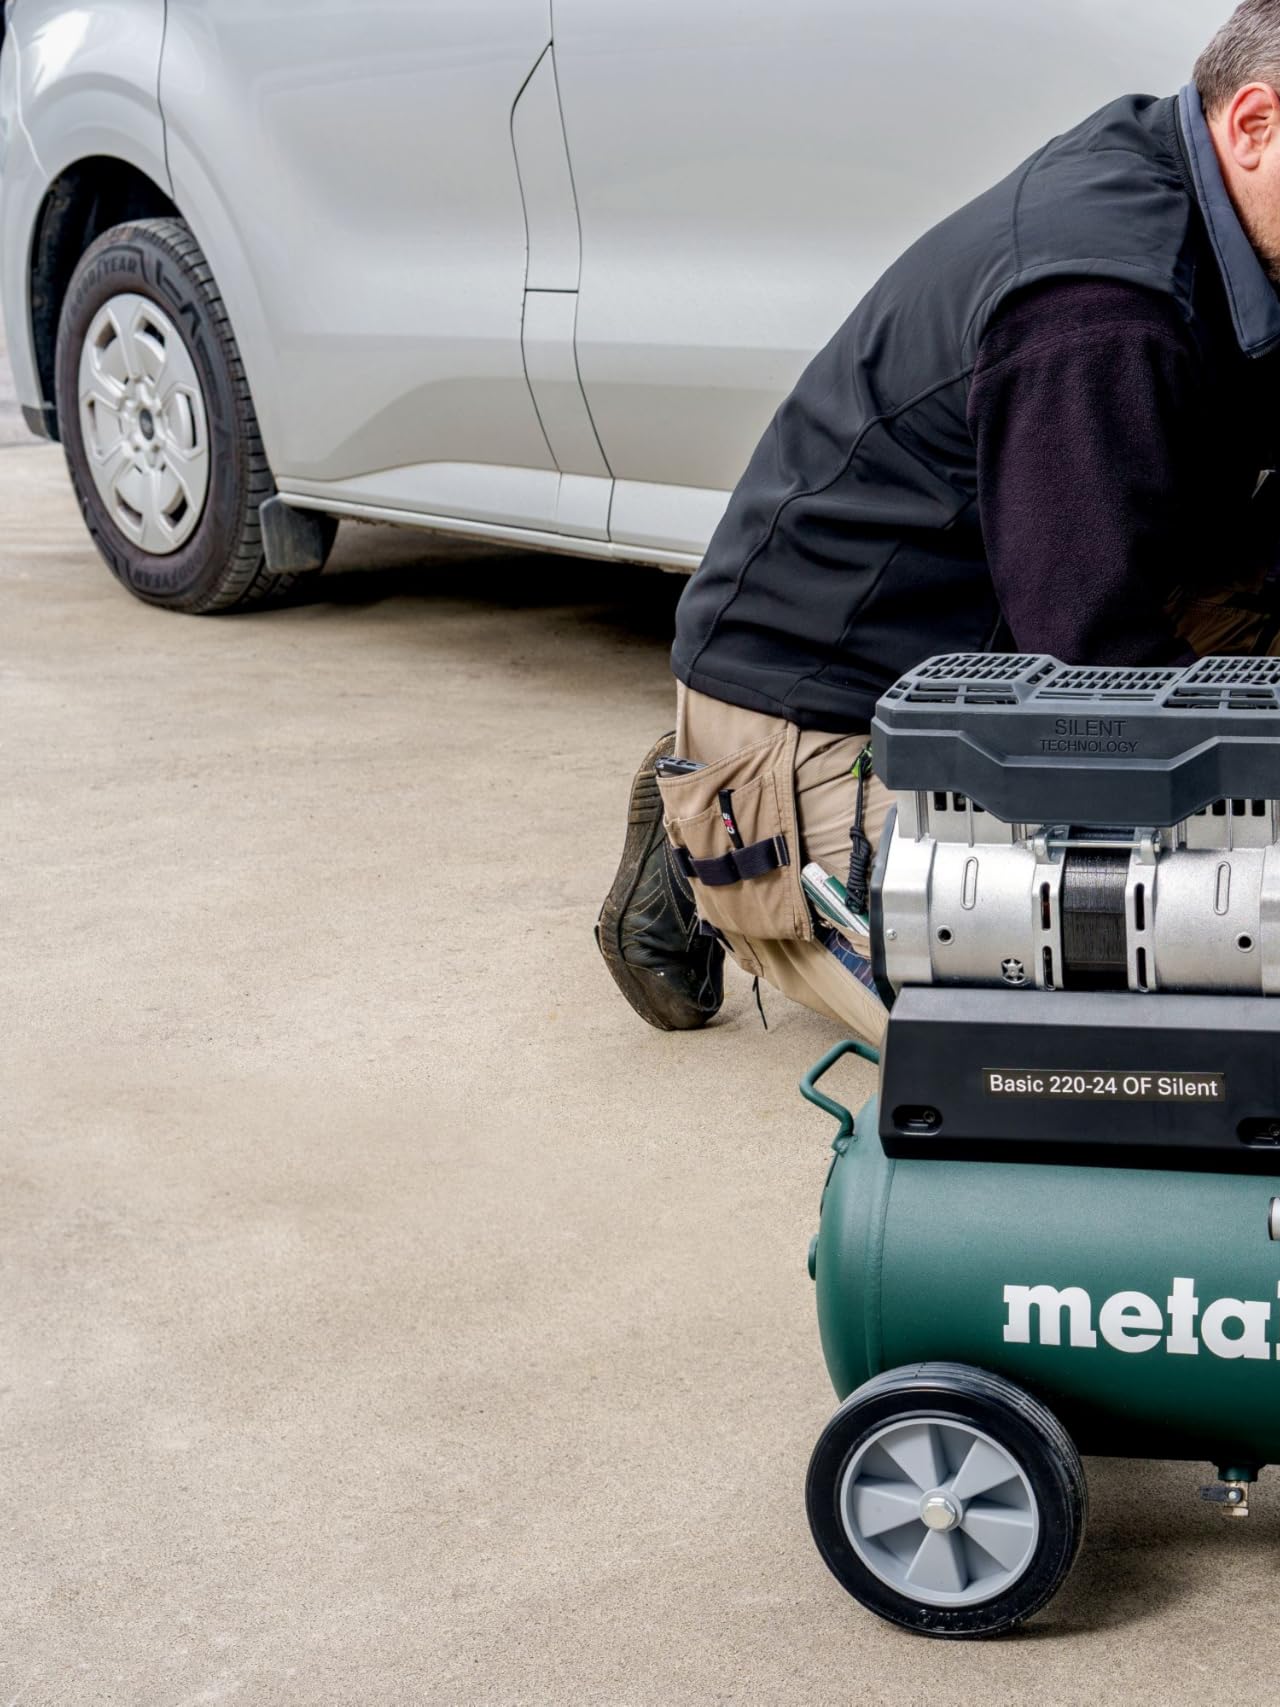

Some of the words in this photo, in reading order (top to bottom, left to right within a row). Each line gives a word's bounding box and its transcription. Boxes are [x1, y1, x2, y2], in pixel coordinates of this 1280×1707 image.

[1055, 718, 1127, 738] SILENT
[1040, 739, 1138, 753] TECHNOLOGY
[989, 1074, 1044, 1093] Basic
[1049, 1076, 1117, 1094] 220-24
[1122, 1077, 1152, 1095] OF
[1157, 1078, 1218, 1096] Silent
